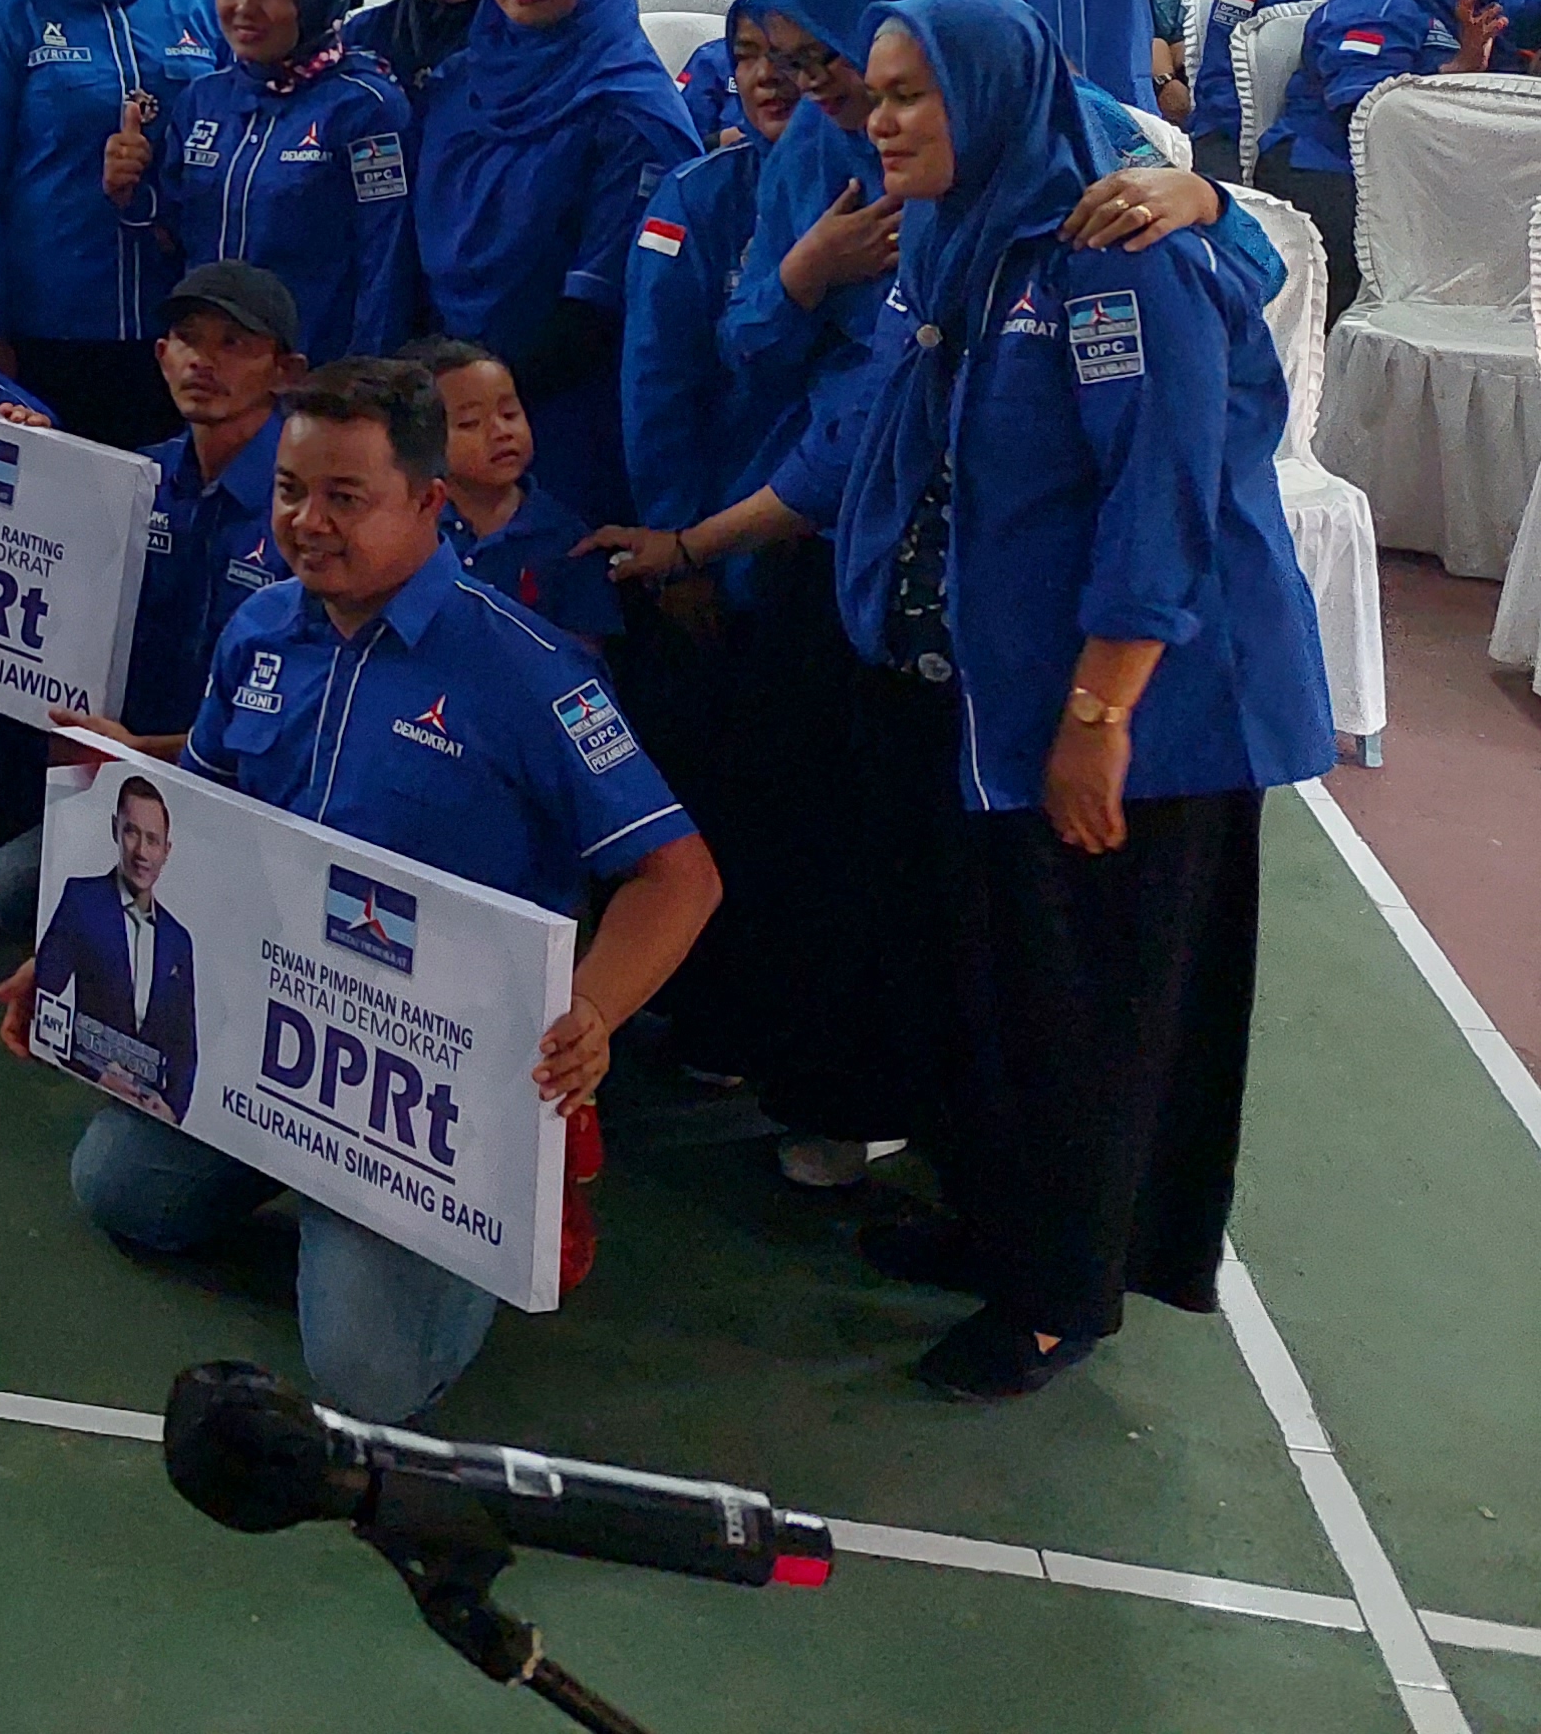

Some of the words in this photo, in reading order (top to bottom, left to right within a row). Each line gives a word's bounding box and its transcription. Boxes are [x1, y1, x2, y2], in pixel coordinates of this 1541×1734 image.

[279, 150, 334, 163] DEMOKRAT
[364, 168, 393, 183] DPC
[1086, 340, 1126, 358] DPC
[1, 524, 65, 561] RANTING
[240, 689, 274, 709] TONI
[391, 718, 465, 758] DEMOKRAT
[587, 725, 618, 749] DPC
[261, 938, 316, 981] DEWAN
[319, 964, 398, 1016] PIMPINAN
[400, 999, 474, 1050] RANTING
[269, 966, 336, 1016] PARTAI
[342, 1002, 464, 1072] DEMOKRAT
[261, 998, 459, 1167] DPRt
[222, 1085, 340, 1166] KELURAHAN
[344, 1146, 436, 1213] SIMPANG
[441, 1194, 502, 1247] BARU
